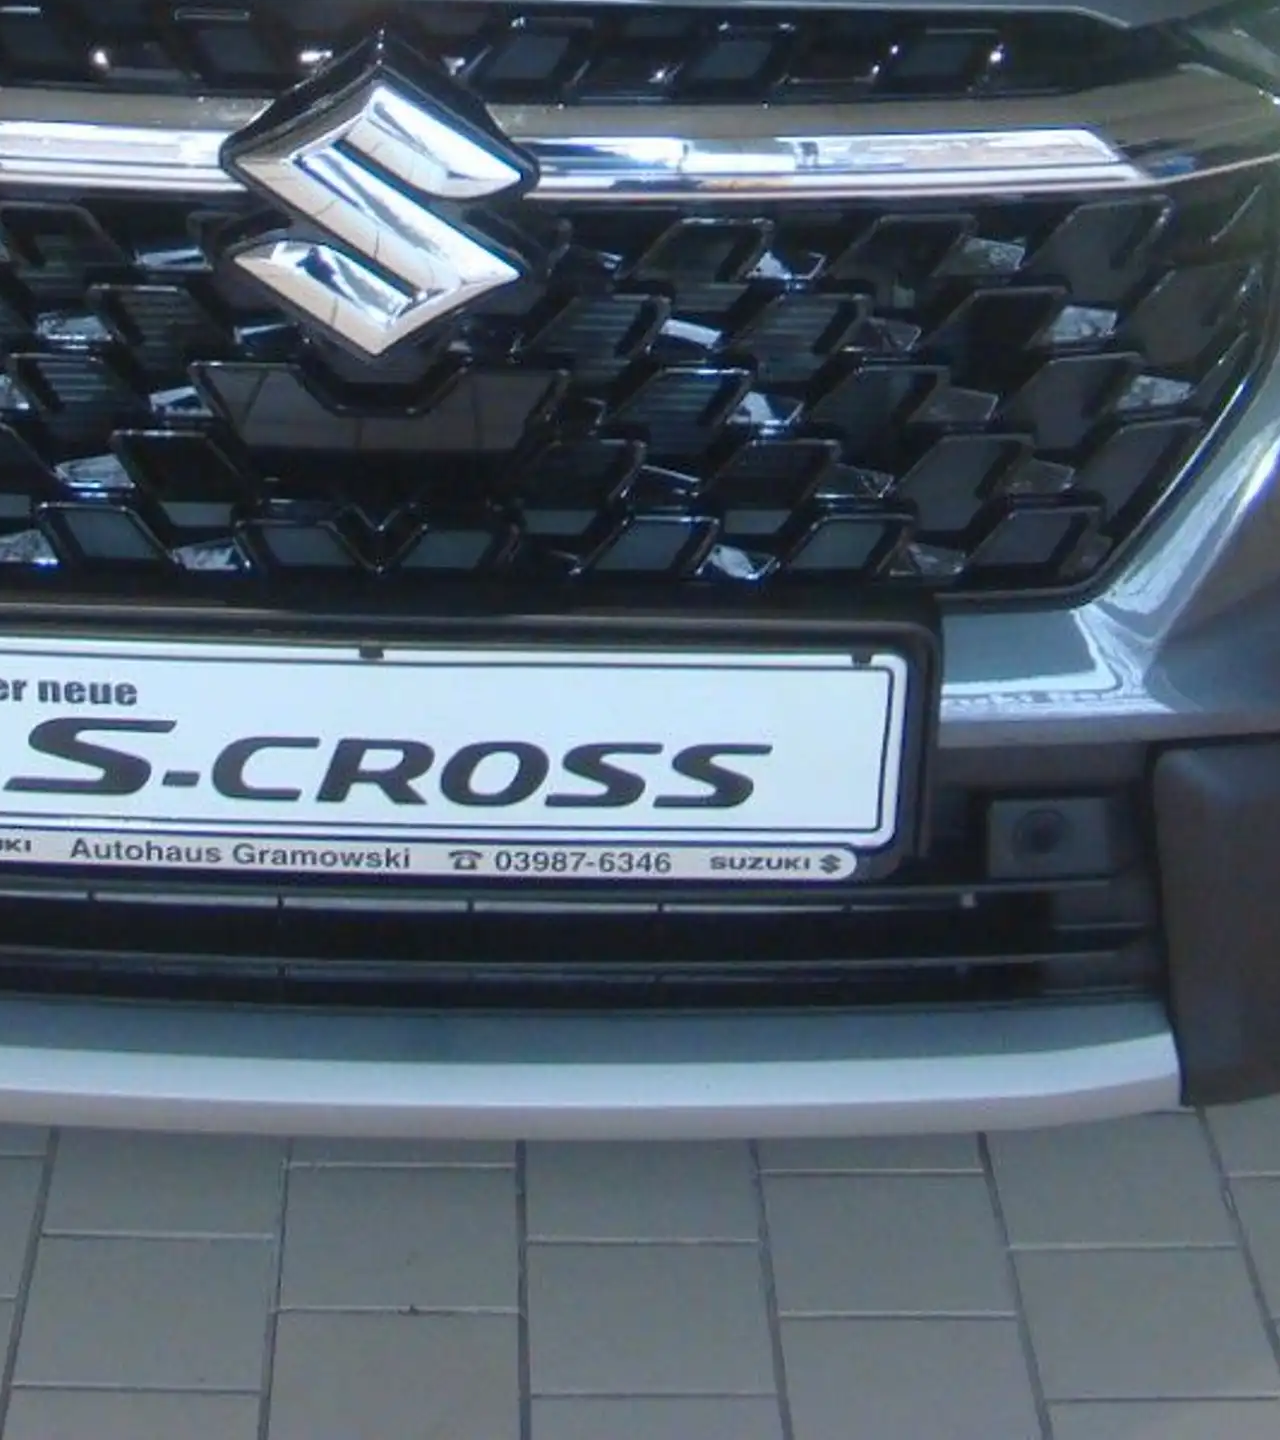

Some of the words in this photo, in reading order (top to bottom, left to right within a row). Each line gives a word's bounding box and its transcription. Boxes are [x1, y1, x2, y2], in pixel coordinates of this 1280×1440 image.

[37, 678, 138, 707] neue
[3, 716, 773, 808] S-CROSS
[70, 837, 222, 864] Autohaus
[232, 844, 411, 872] Gramowski
[494, 851, 673, 874] 03987-6346
[709, 855, 812, 871] SUZUKI
